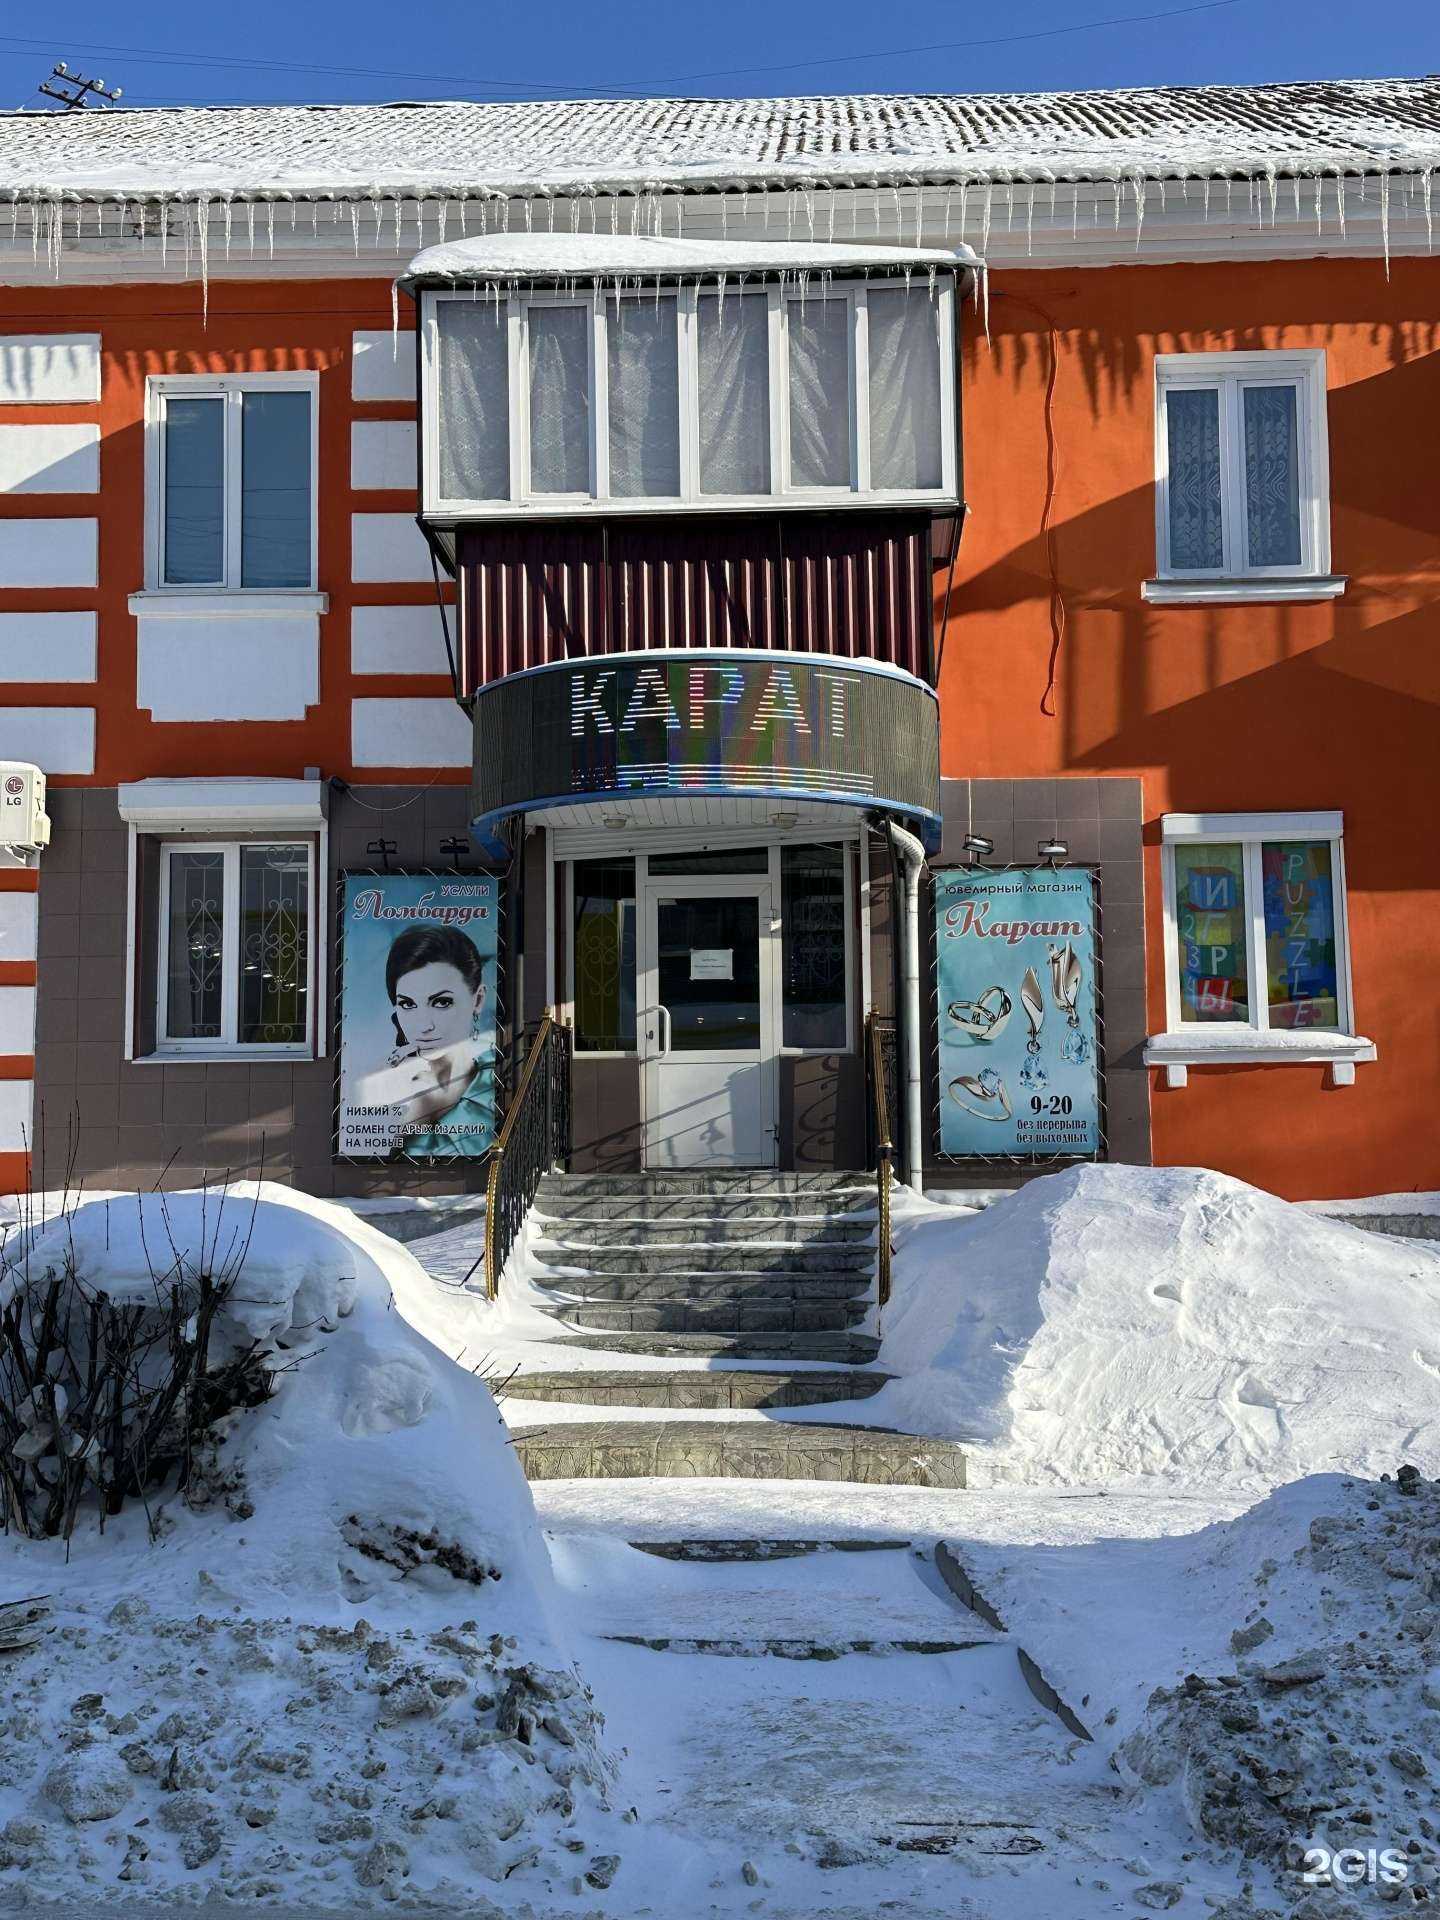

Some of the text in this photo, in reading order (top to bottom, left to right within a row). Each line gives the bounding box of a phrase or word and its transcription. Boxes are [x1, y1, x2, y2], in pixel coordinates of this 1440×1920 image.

[571, 667, 861, 737] КАРАТ
[6, 797, 22, 806] LG
[441, 885, 490, 897] УСЛУГИ
[945, 882, 1082, 895] ювелирный магазин
[352, 889, 490, 926] Ломбарда
[945, 900, 1085, 945] Карат
[346, 1105, 389, 1116] НИЗКИЙ
[1030, 1095, 1073, 1115] 9-20
[346, 1123, 486, 1135] ОБМЕН СТАРЫХ ИЗДЕЛИЙ
[1017, 1119, 1087, 1131] без перерыва
[345, 1138, 404, 1148] НА НОВЫЕ
[1016, 1133, 1088, 1144] без выходных
